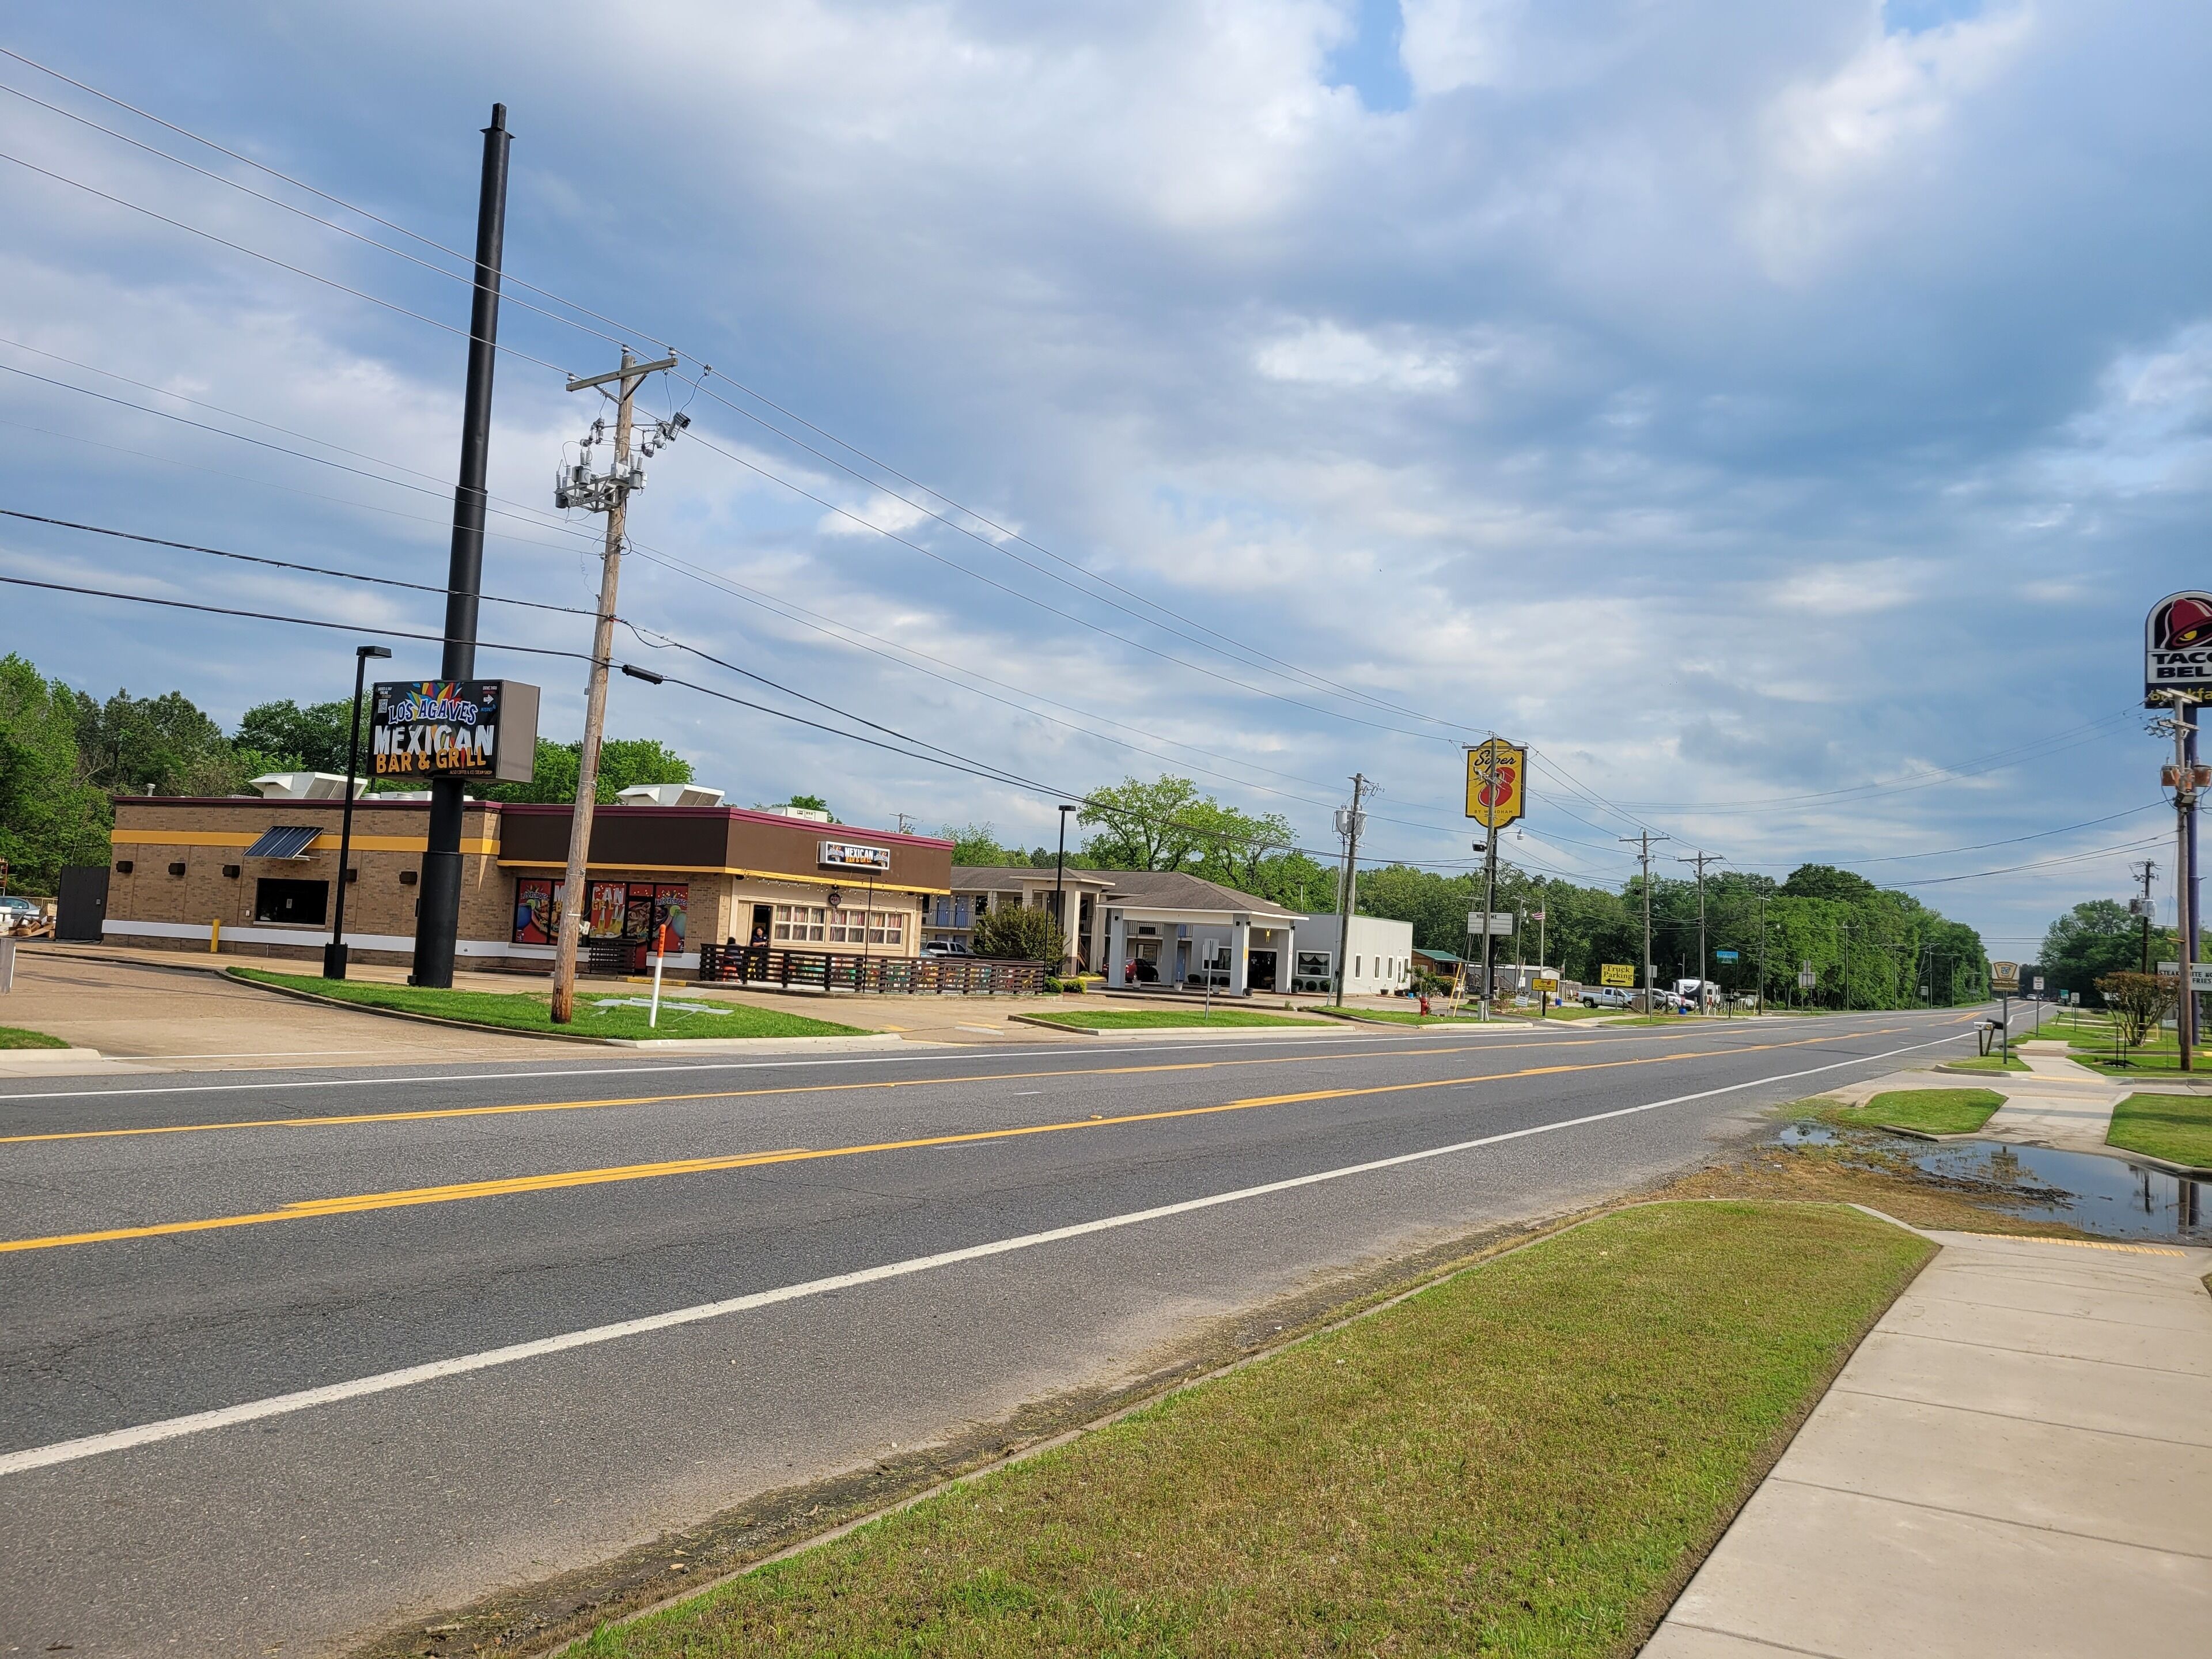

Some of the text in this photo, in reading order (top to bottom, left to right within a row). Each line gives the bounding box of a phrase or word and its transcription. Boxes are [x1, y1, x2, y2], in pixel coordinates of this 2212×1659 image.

[388, 698, 479, 725] LOS AGAVES
[373, 725, 495, 756] MEXICAN
[377, 751, 412, 774] BAR
[418, 751, 430, 770] &
[844, 847, 874, 860] MEXICAN
[1603, 971, 1633, 981] Parking
[1605, 965, 1630, 973] Truck
